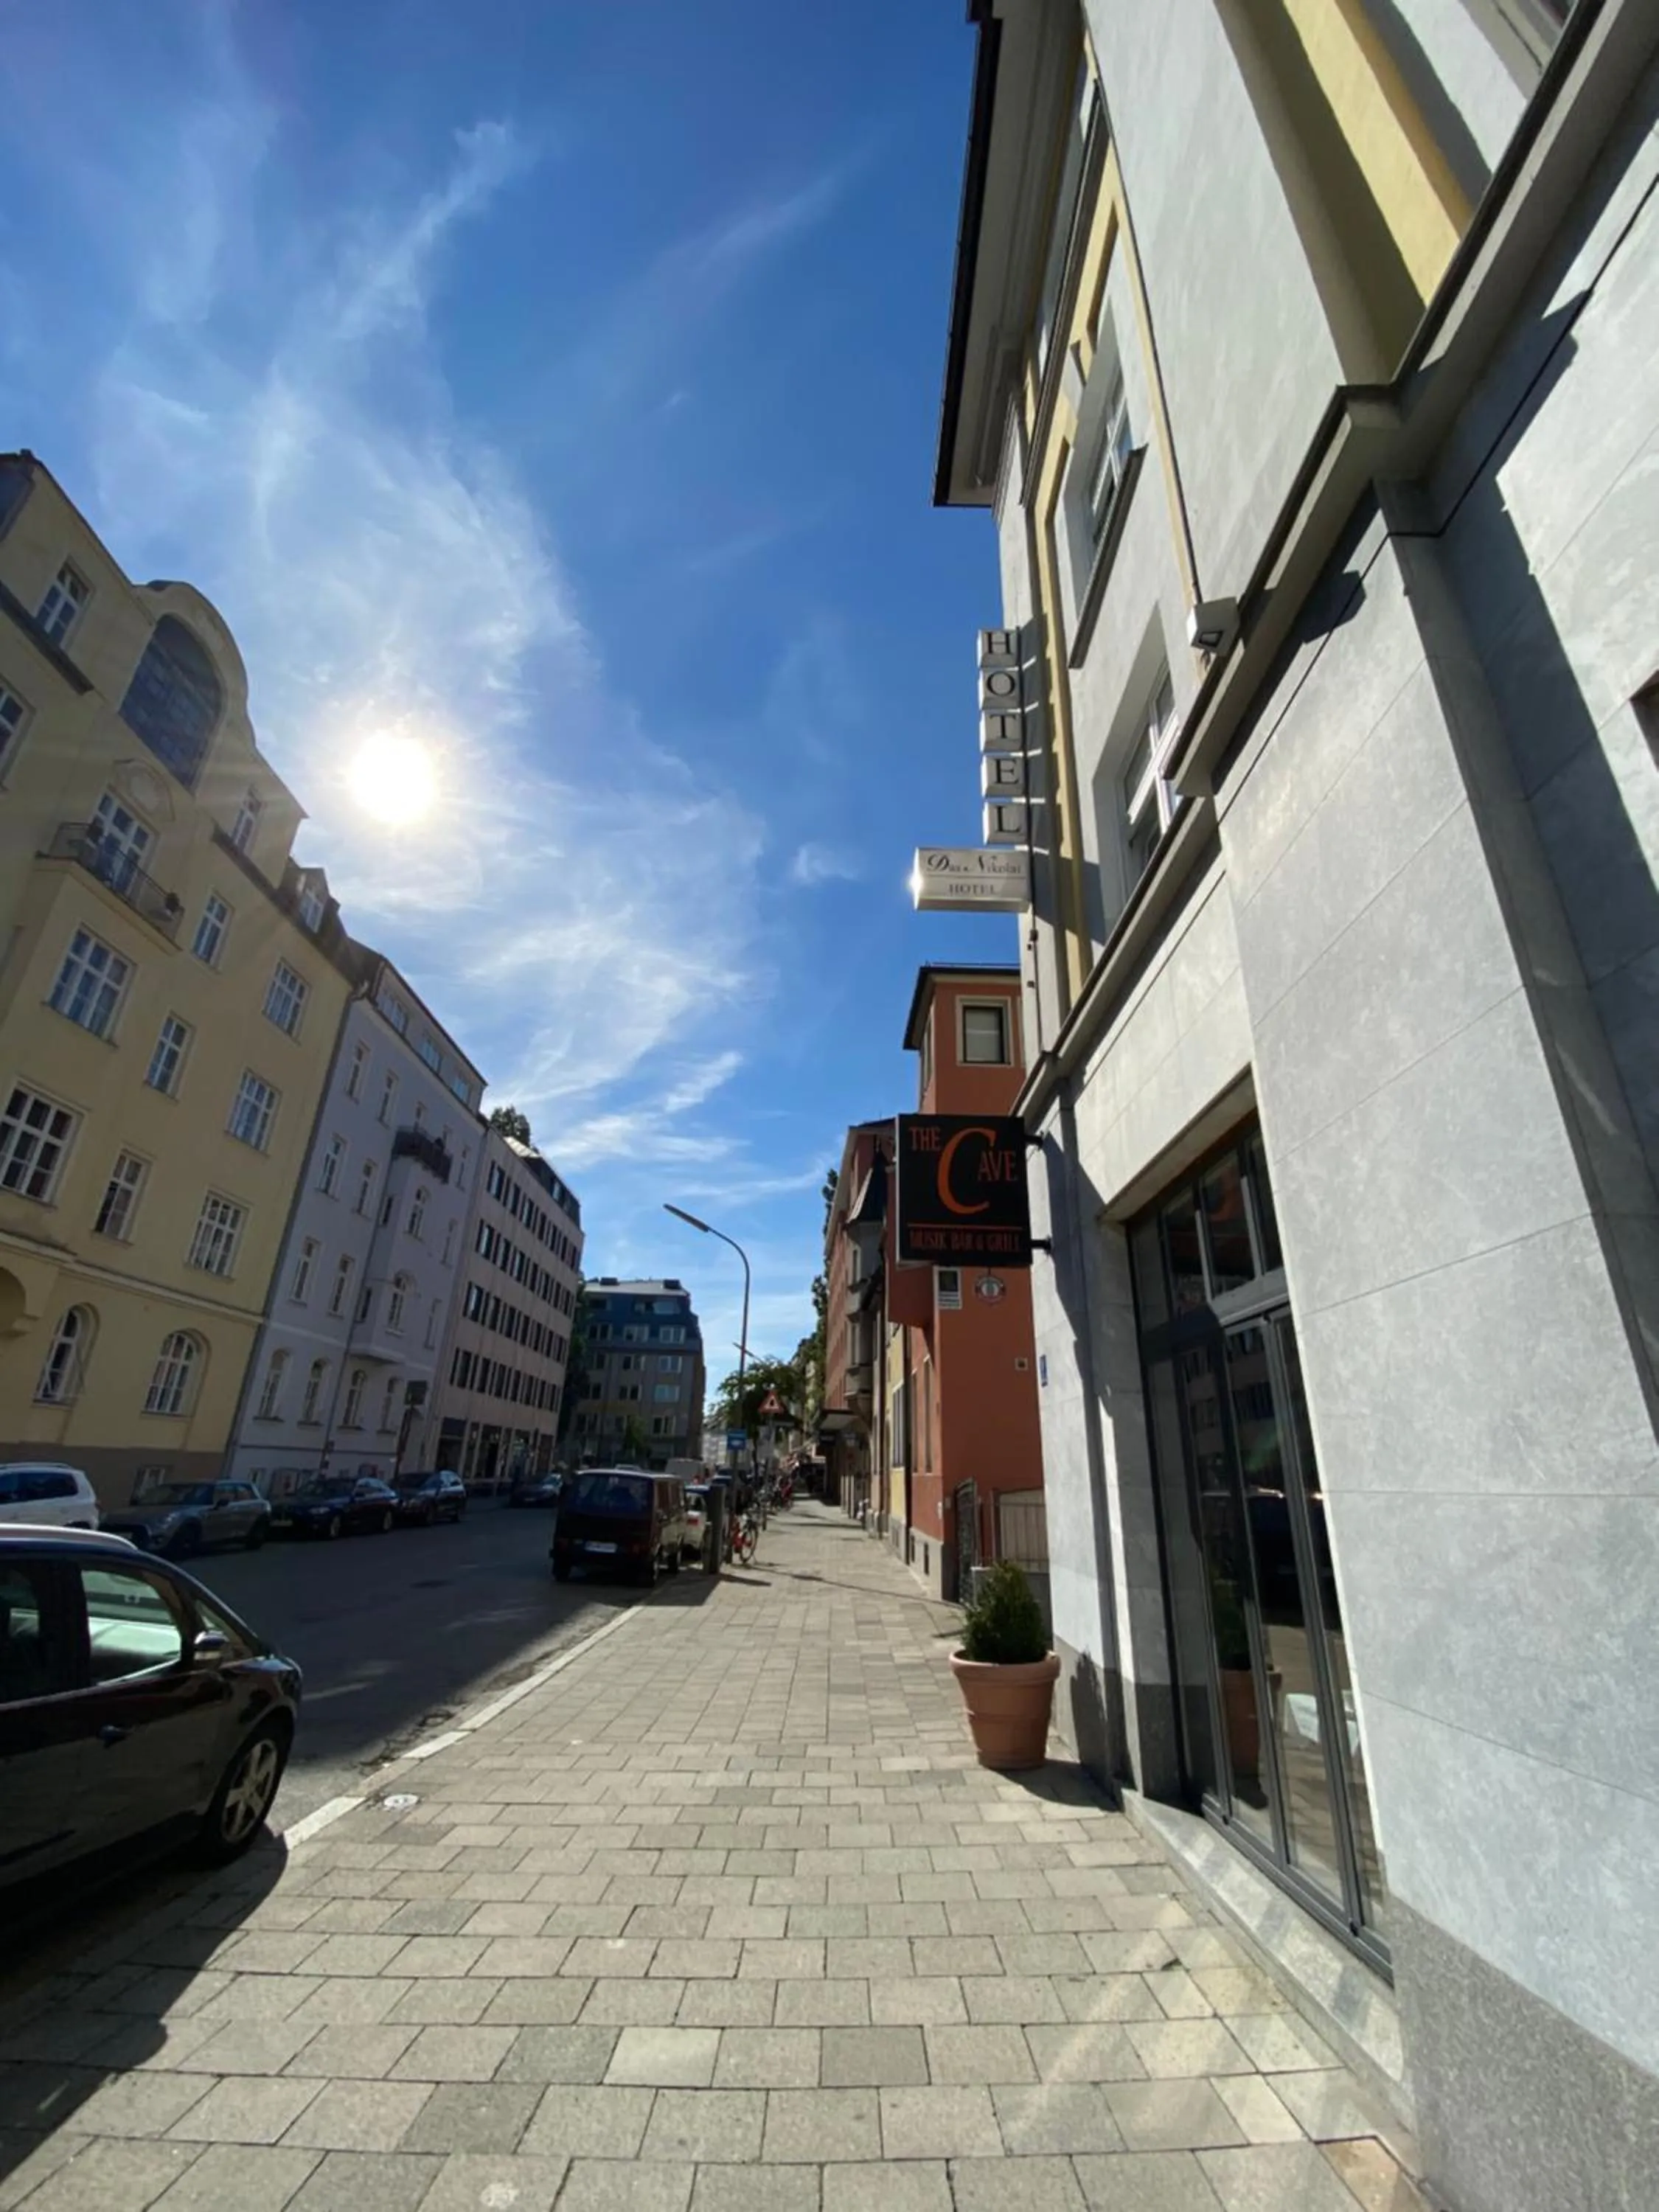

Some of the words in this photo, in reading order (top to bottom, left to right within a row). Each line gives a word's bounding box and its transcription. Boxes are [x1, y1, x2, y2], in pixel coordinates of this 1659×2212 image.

[986, 631, 1022, 834] HOTEL
[949, 884, 995, 895] HOTEL
[908, 1127, 942, 1151] THE
[937, 1127, 1018, 1214] CAVE
